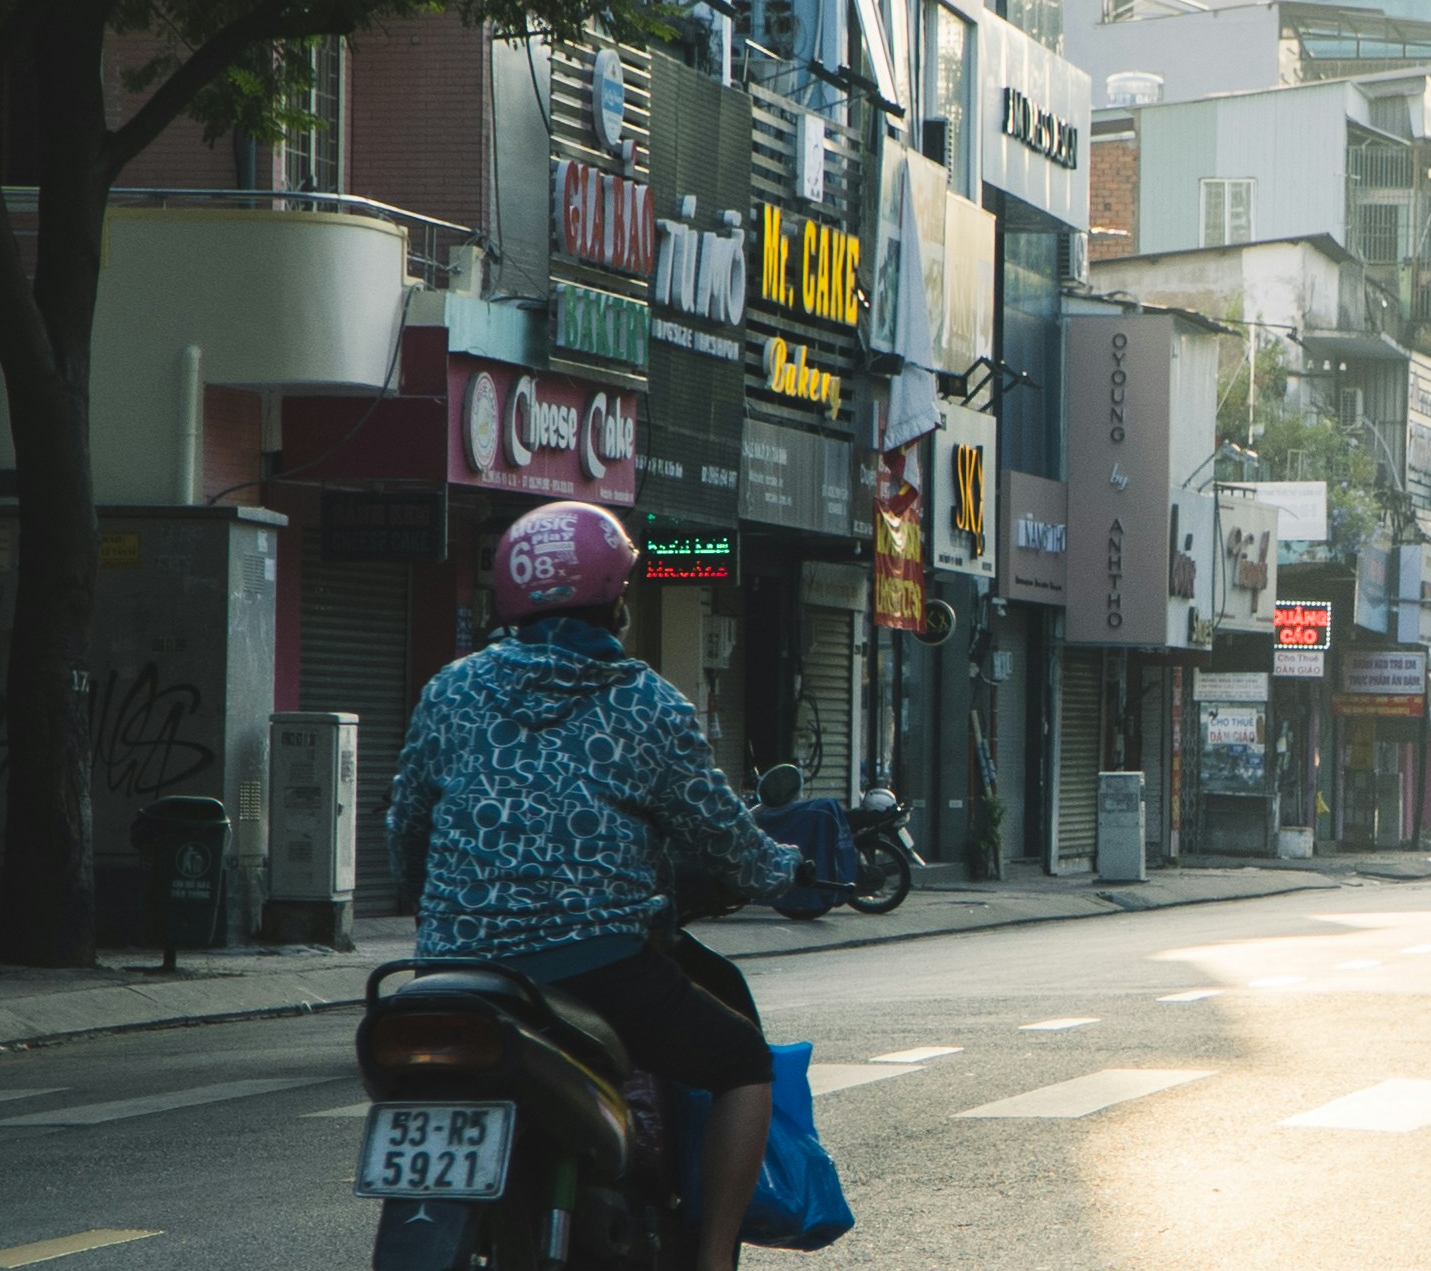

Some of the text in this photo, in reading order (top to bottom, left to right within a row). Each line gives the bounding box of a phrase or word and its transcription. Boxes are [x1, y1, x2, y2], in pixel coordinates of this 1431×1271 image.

[761, 201, 860, 327] Mr. CAKE
[766, 336, 842, 421] Bakery
[506, 374, 634, 479] Cheese Cake
[1110, 462, 1129, 490] by
[390, 530, 430, 553] CAKE
[510, 517, 578, 543] MUSIC
[1232, 716, 1254, 727] THUÊ
[381, 1150, 479, 1188] 5921
